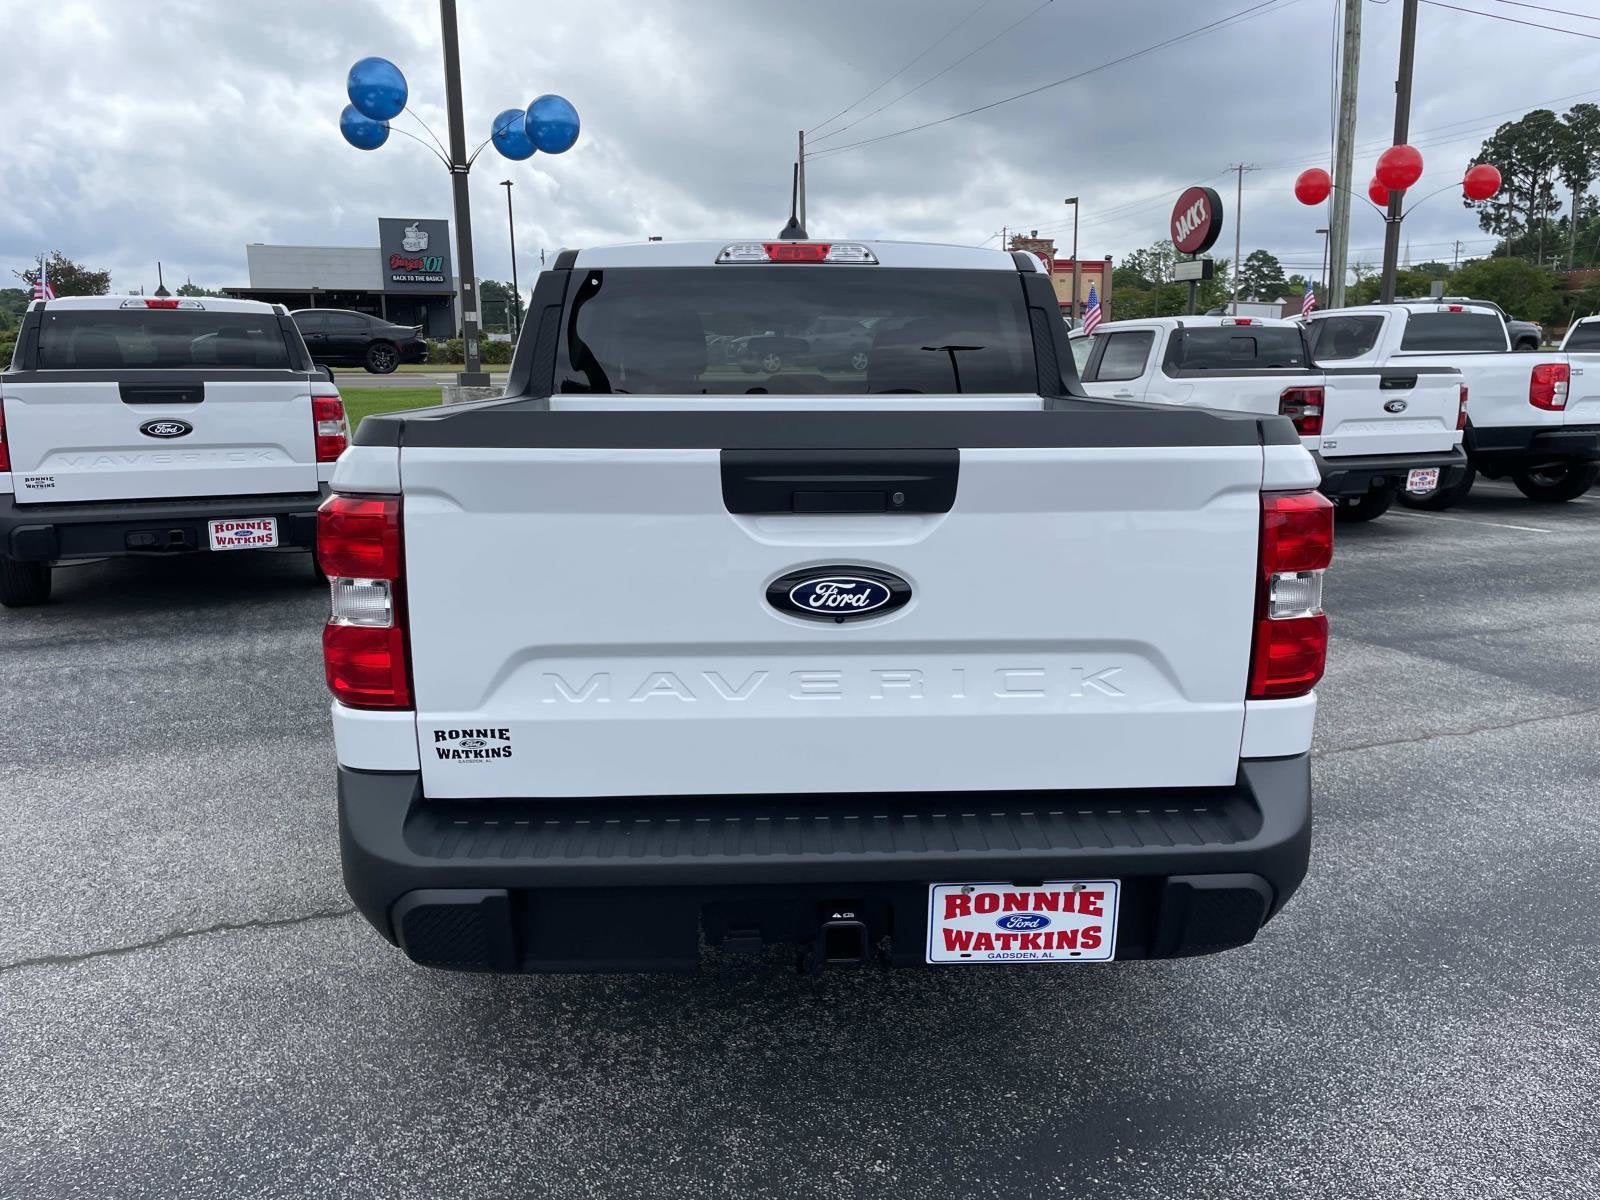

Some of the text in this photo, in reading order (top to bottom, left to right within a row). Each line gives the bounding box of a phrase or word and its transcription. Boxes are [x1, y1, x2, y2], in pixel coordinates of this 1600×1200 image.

[1175, 198, 1206, 242] JACK'S
[154, 423, 178, 434] Ford
[214, 521, 272, 534] RONNIE
[215, 533, 273, 545] WATKINS
[808, 582, 871, 608] Ford
[541, 666, 1127, 705] MAVERICK
[434, 728, 511, 742] RONNIE
[436, 745, 513, 760] WATKINS
[944, 890, 1105, 920] RONNIE
[1008, 916, 1040, 930] Ford
[943, 925, 1102, 952] WATKINS
[987, 952, 1039, 960] GADSDEN,
